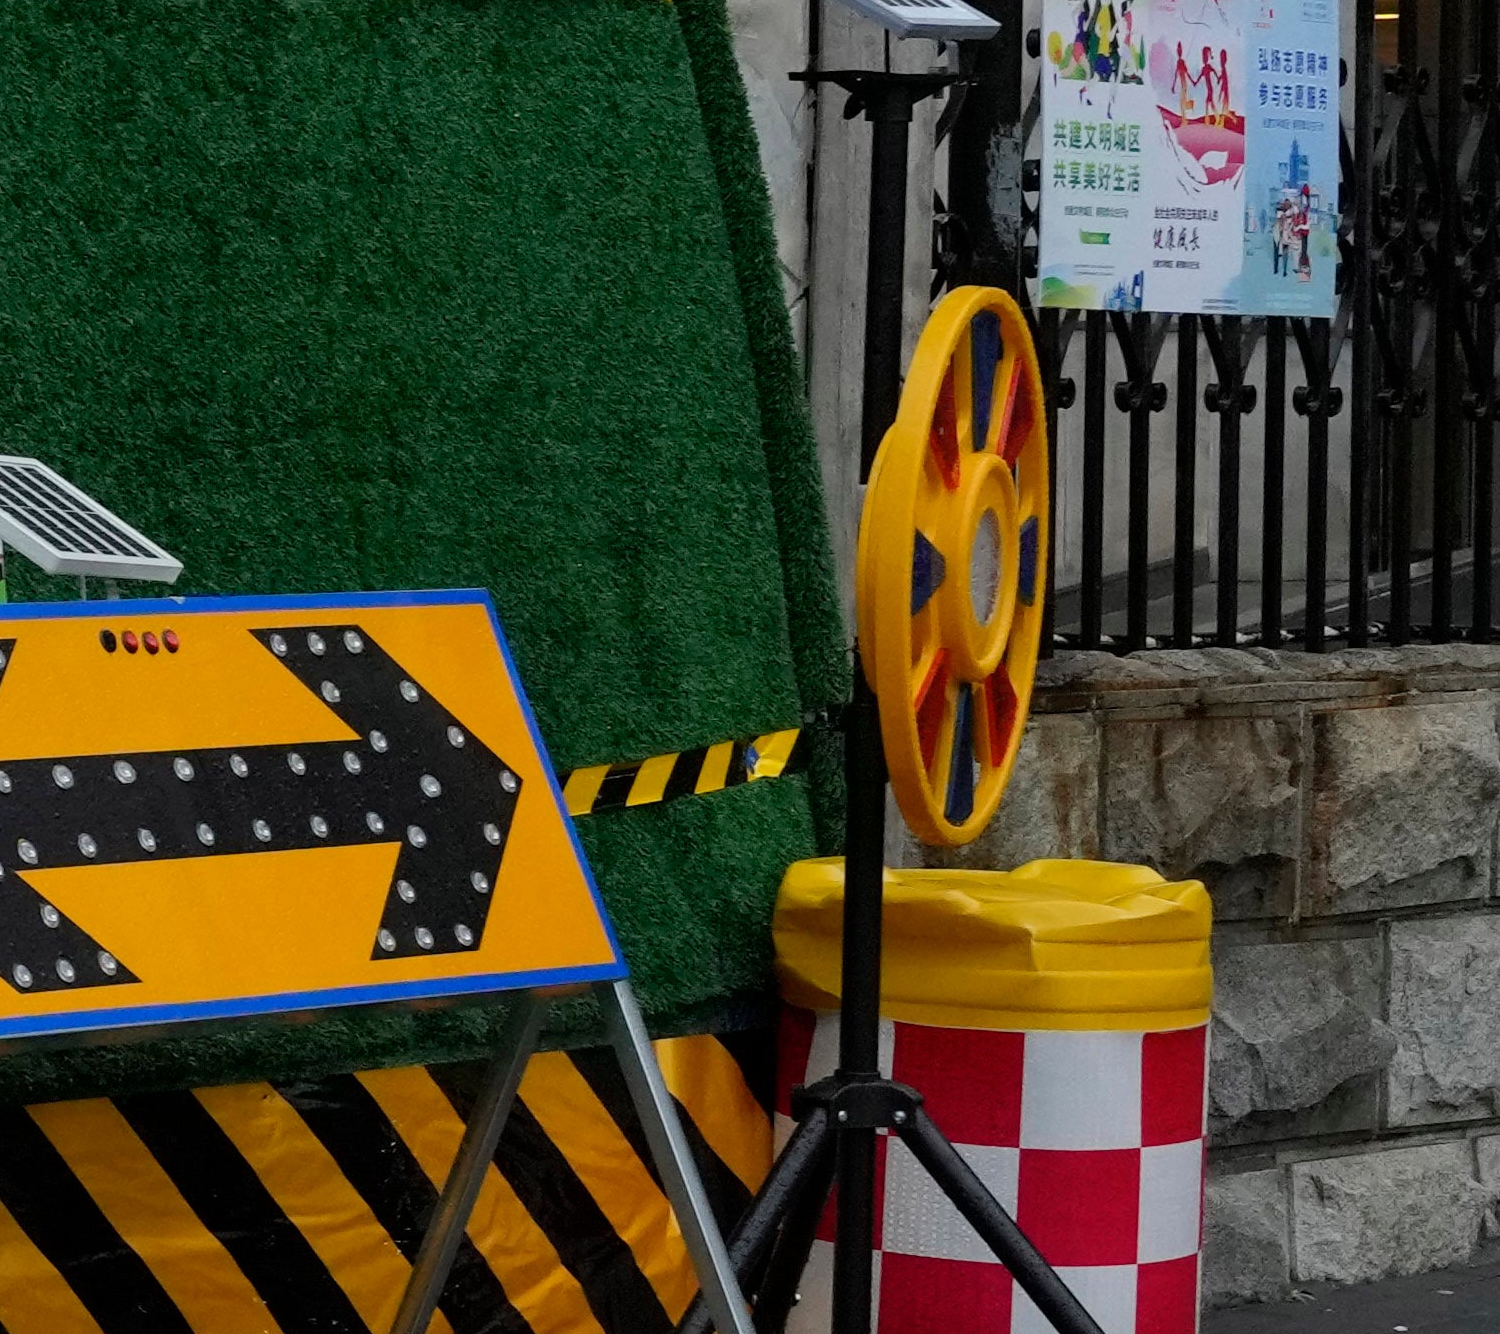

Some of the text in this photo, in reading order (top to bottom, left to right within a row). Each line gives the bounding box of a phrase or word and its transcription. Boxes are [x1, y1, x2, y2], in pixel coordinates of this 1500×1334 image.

[1053, 119, 1141, 153] 共建文明城区
